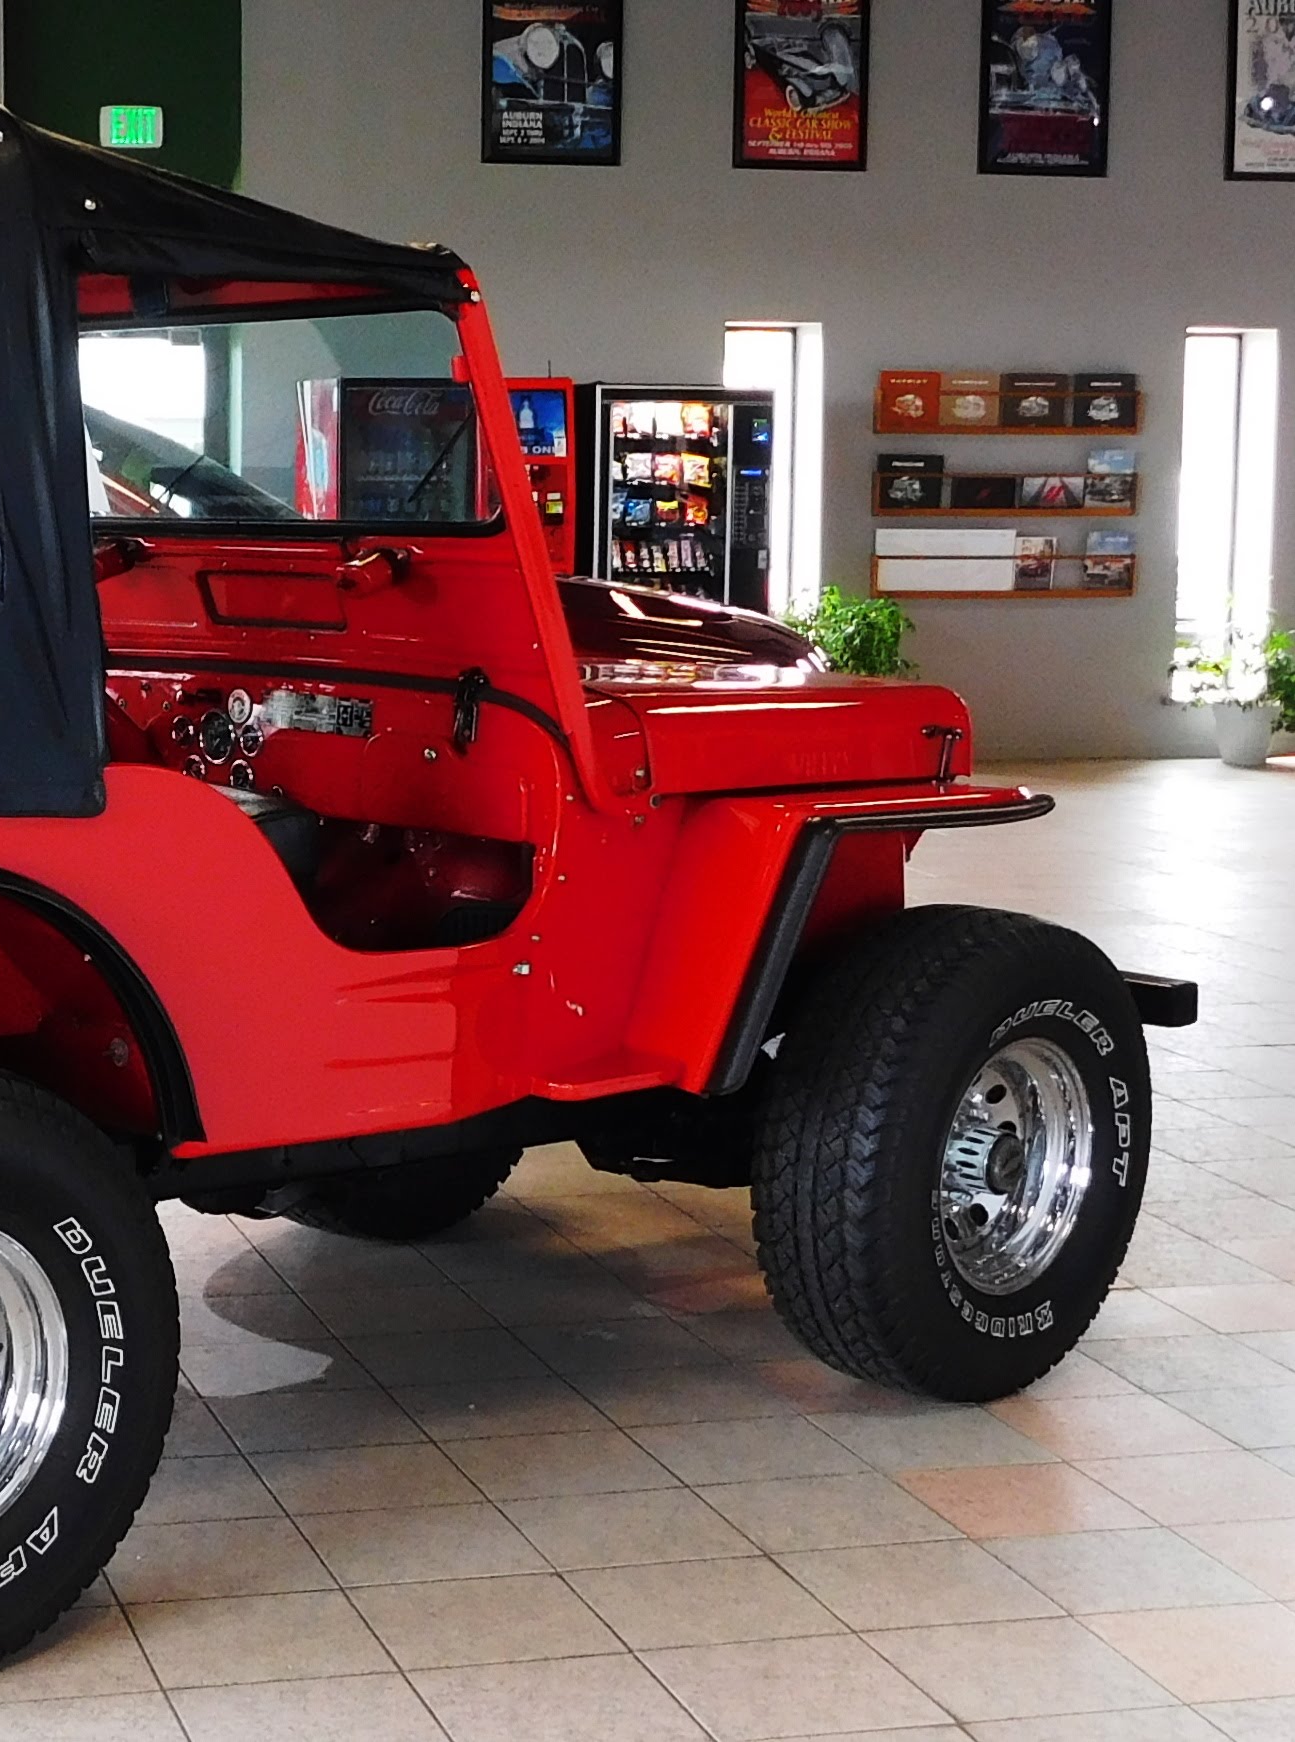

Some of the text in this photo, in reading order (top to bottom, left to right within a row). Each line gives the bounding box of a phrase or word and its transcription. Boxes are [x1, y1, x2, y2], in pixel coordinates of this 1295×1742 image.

[1244, 0, 1295, 16] AUB
[502, 111, 543, 120] AUBURN
[111, 108, 156, 144] EXIT
[502, 120, 543, 129] INDIANA
[749, 116, 852, 131] CLASSIC CAR SHOW
[768, 127, 833, 142] & FESTIVAL
[988, 999, 1114, 1056] DUELER
[53, 1216, 124, 1483] DUELER
